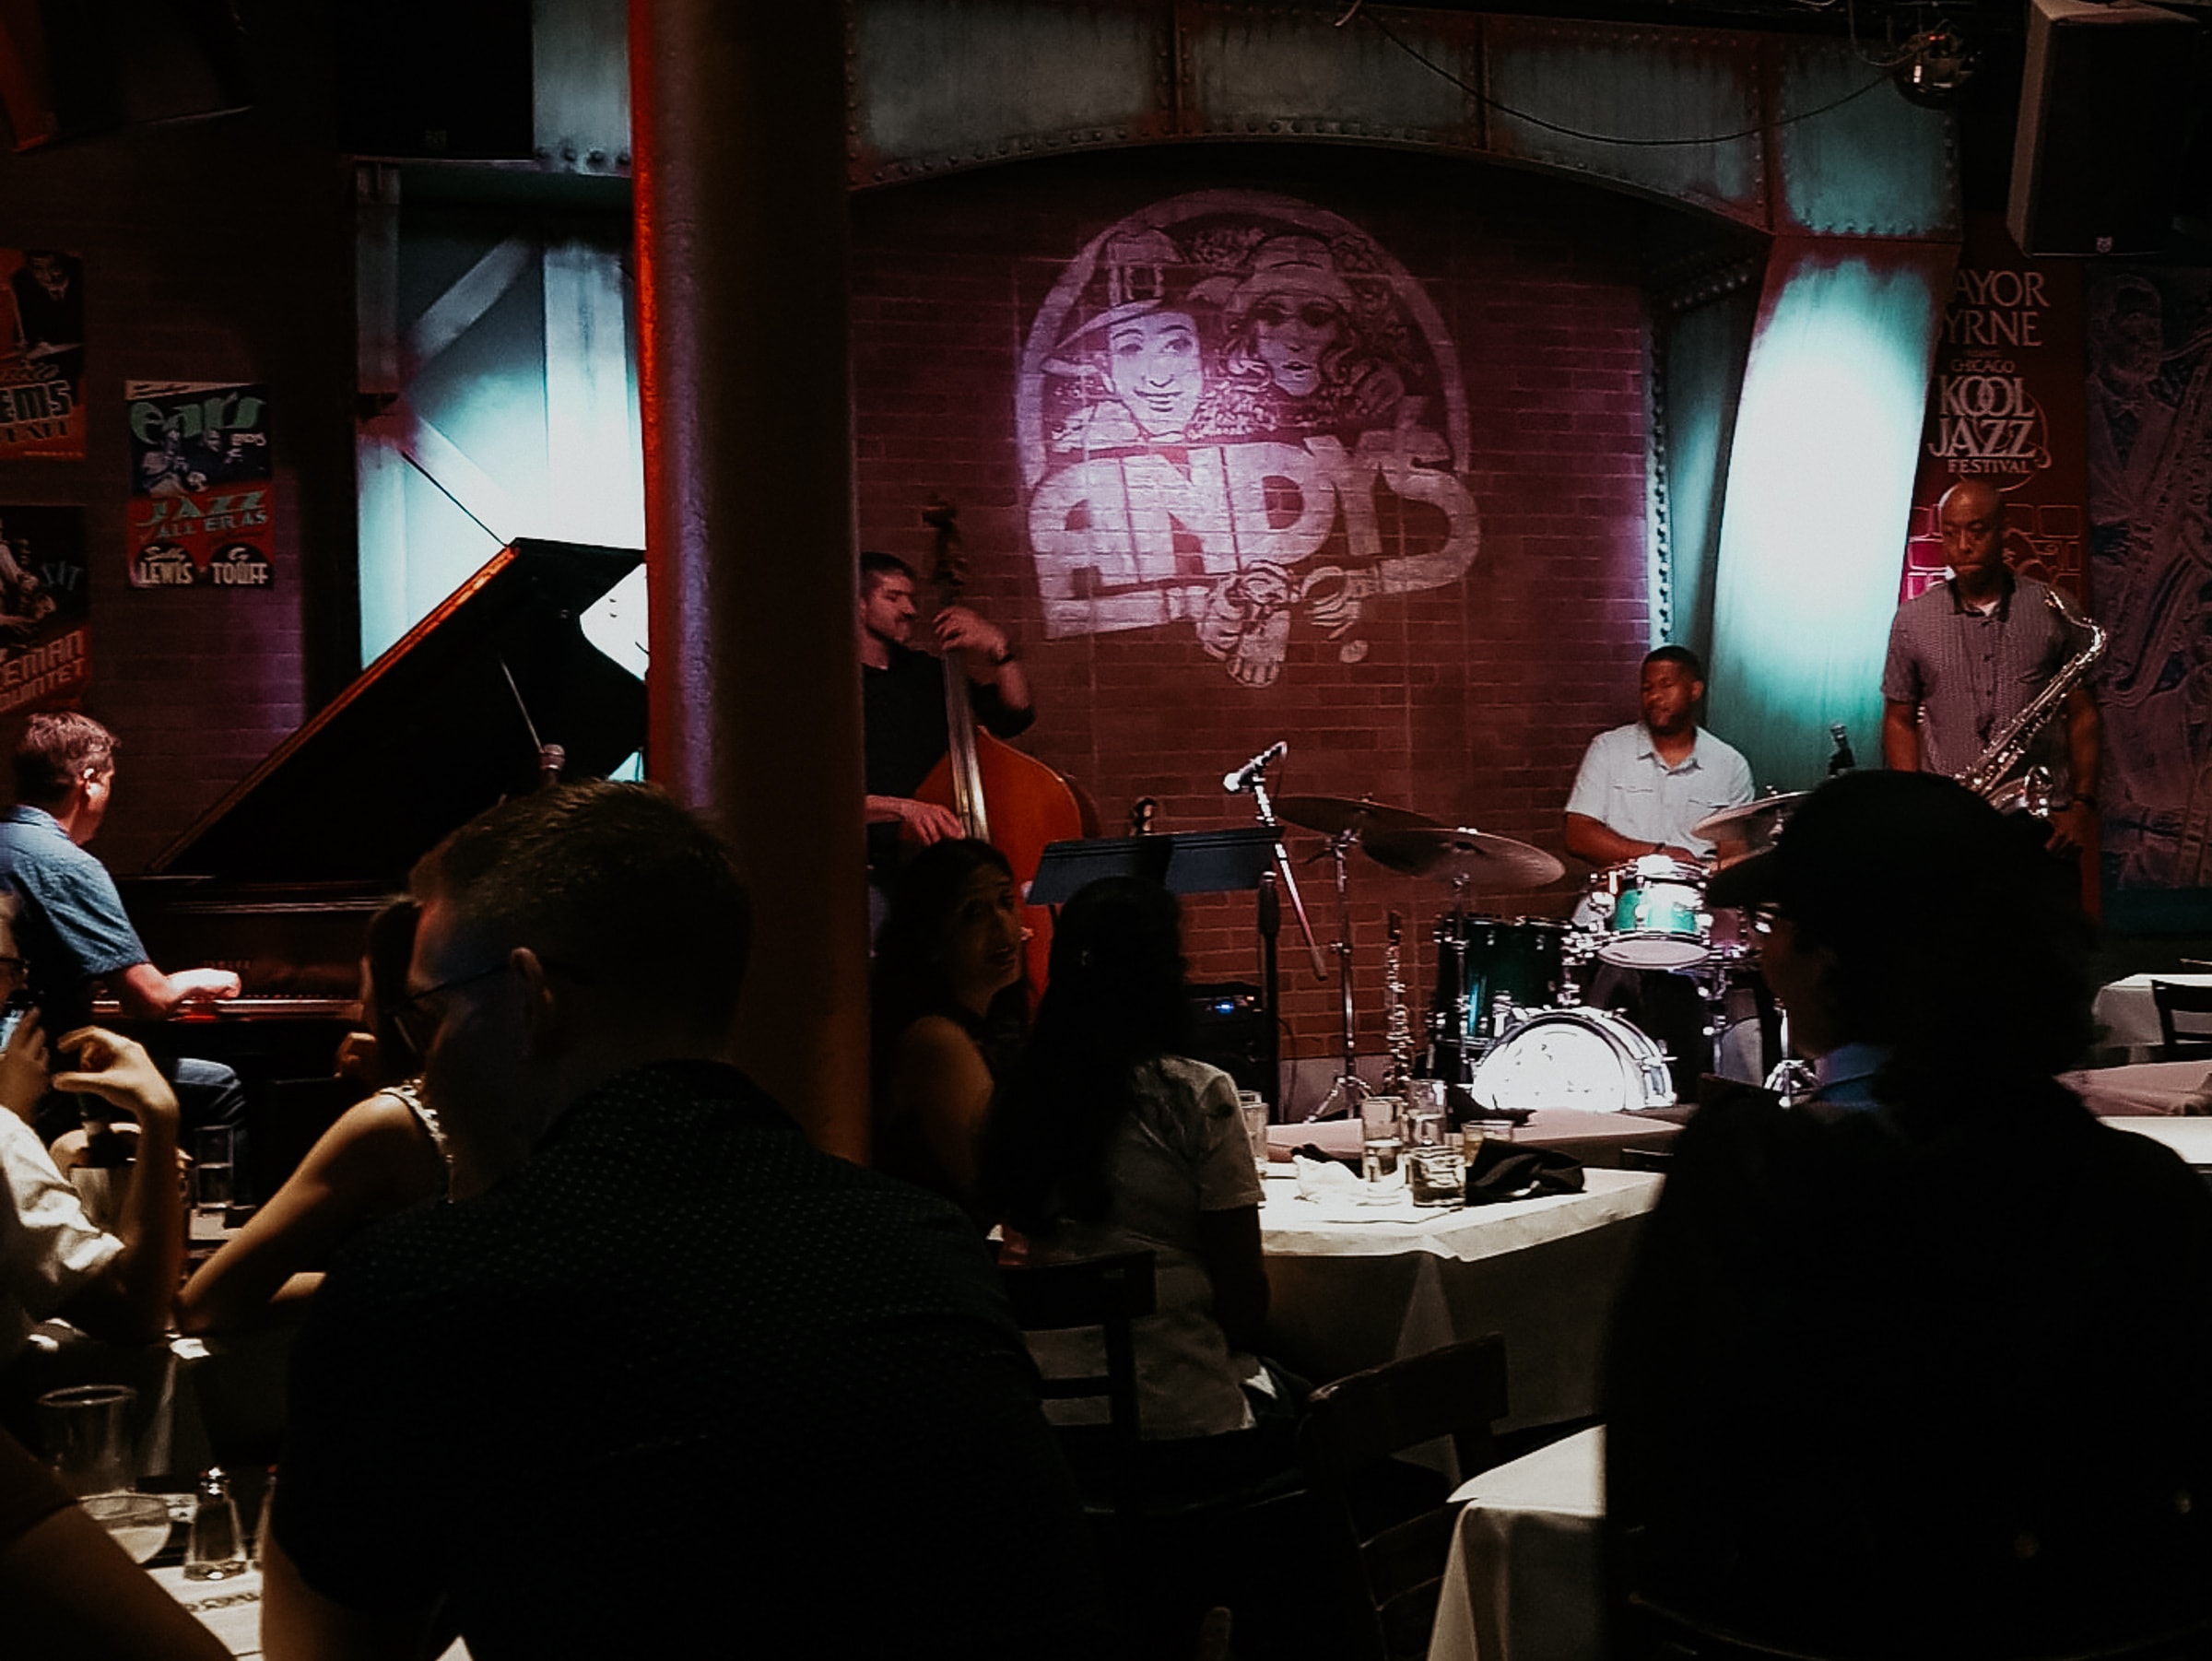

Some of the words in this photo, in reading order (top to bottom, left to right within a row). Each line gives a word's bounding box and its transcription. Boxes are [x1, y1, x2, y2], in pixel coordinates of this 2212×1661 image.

[1952, 269, 2052, 309] AYOR
[1945, 309, 2043, 348] YRNE
[1951, 359, 2016, 374] CHICAGO
[1940, 373, 2036, 418] KOOL
[1928, 418, 2038, 458] JAZZ
[1947, 459, 2031, 474] FESTIVAL
[135, 489, 266, 527] JAZZ
[204, 509, 267, 532] ERAS
[138, 561, 194, 584] LEWIS
[0, 630, 85, 686] EMAN
